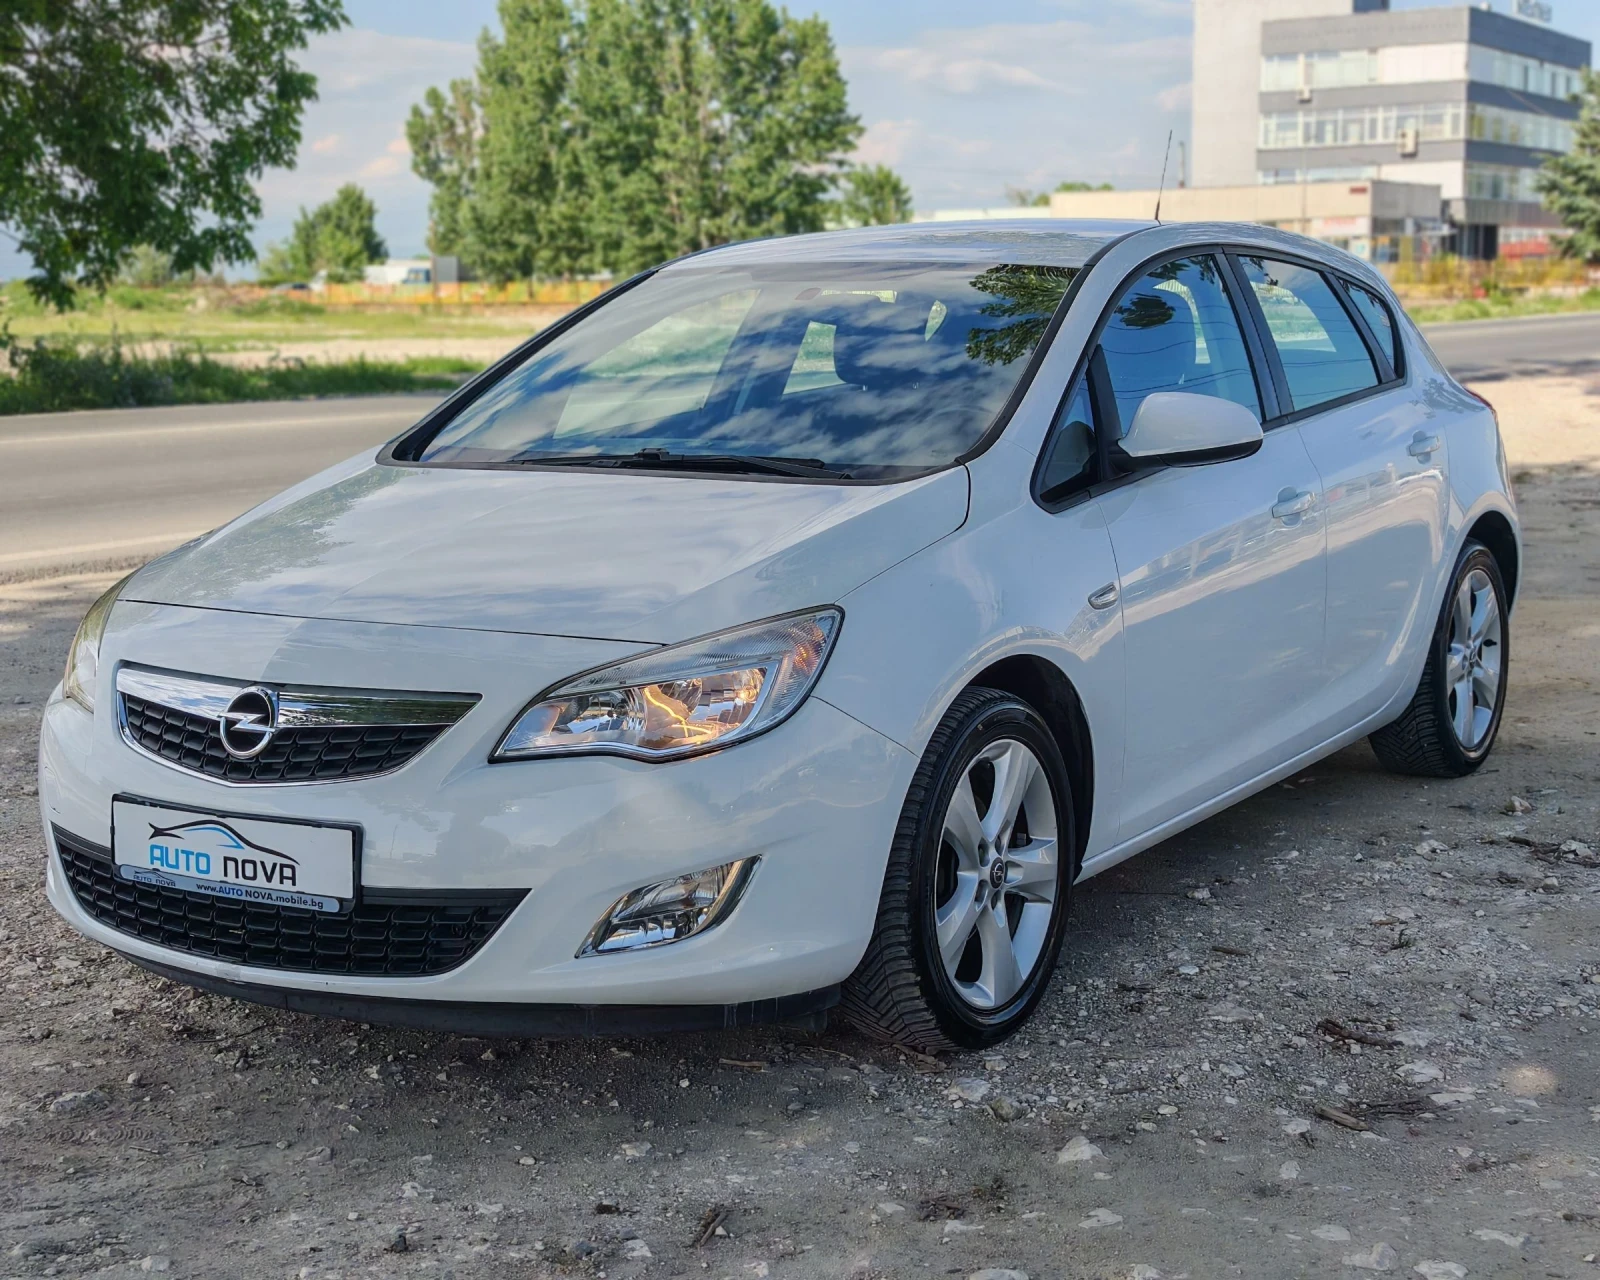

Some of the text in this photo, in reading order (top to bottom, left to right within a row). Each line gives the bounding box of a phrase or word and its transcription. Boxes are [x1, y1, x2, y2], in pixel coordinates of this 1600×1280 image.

[150, 844, 297, 887] AUTO NOVA
[196, 883, 324, 910] www.AUTO NOVA.mobile.bg
